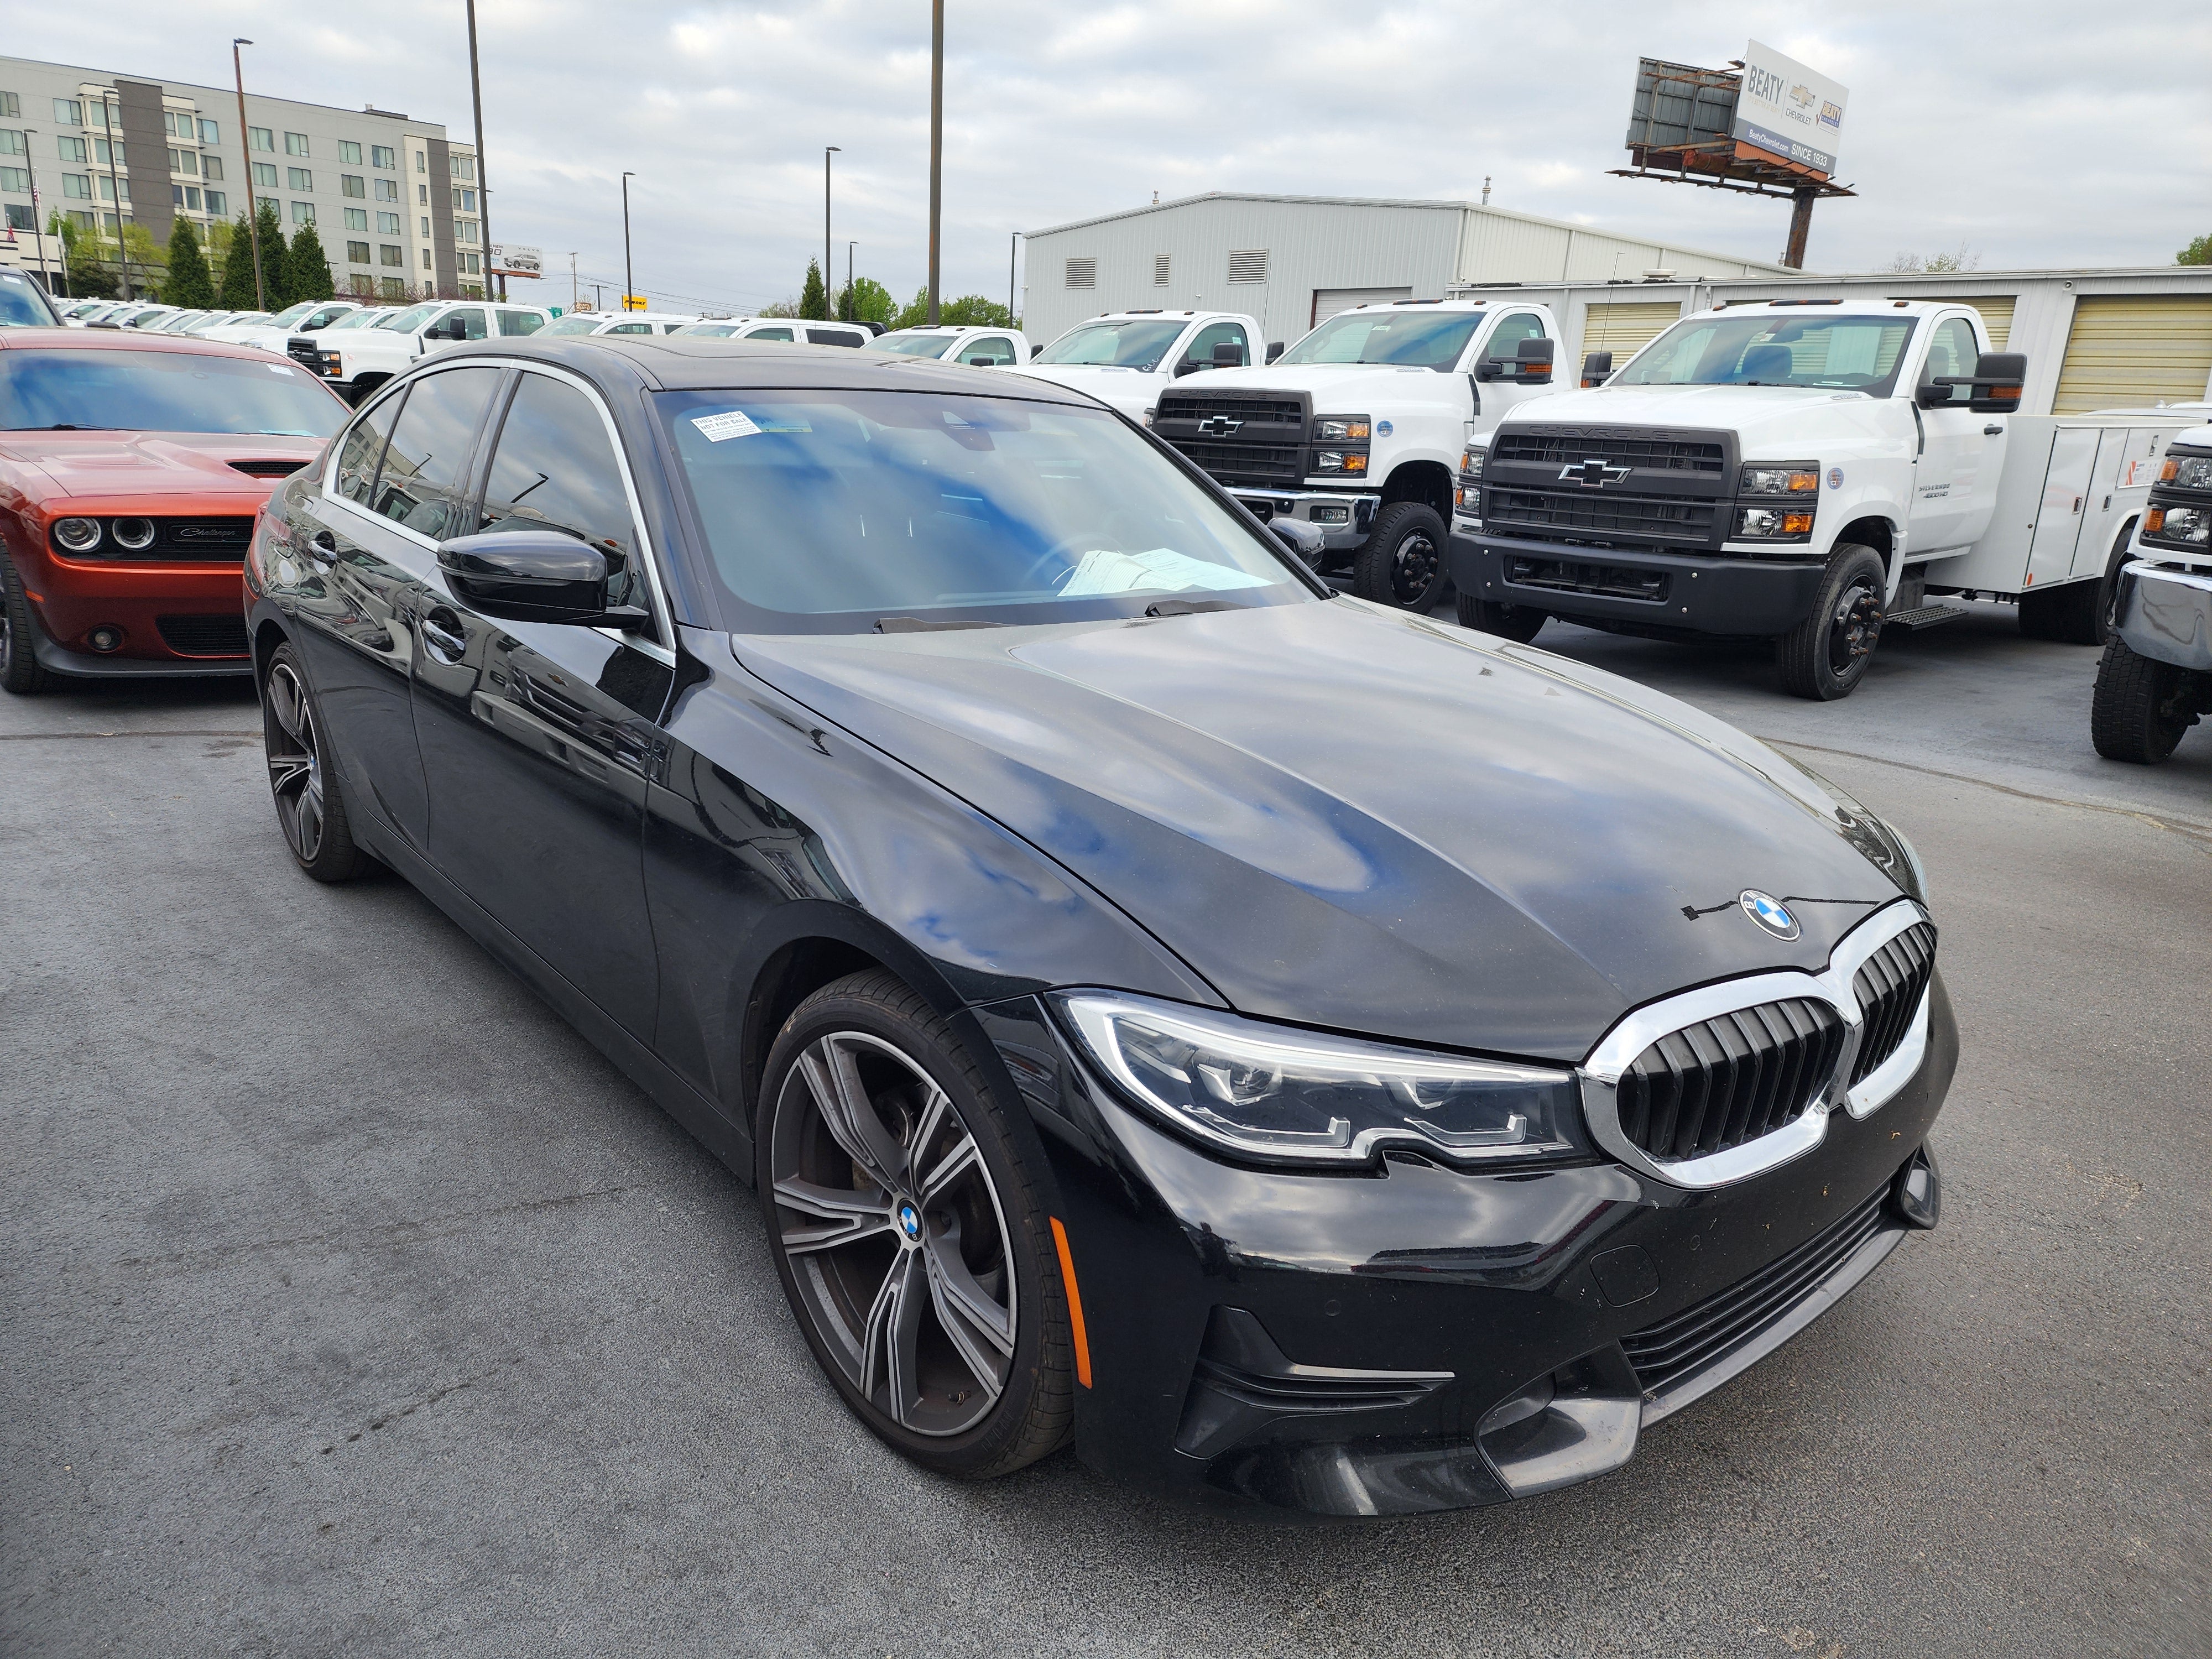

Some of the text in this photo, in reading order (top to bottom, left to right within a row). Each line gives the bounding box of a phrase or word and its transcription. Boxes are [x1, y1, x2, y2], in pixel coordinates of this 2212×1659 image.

[1747, 65, 1784, 105] BEATY
[1786, 108, 1812, 126] CHEVROLET
[1822, 101, 1841, 122] BEATY
[1749, 129, 1789, 153] BeatyChevrolet.com
[1791, 144, 1828, 166] SINCE 1933
[1180, 391, 1280, 400] CHEVROLET
[712, 412, 744, 421] VEHICLE
[1528, 426, 1689, 442] CHEVROLET
[1918, 483, 1950, 492] SILVERADO
[180, 528, 236, 538] Challenger
